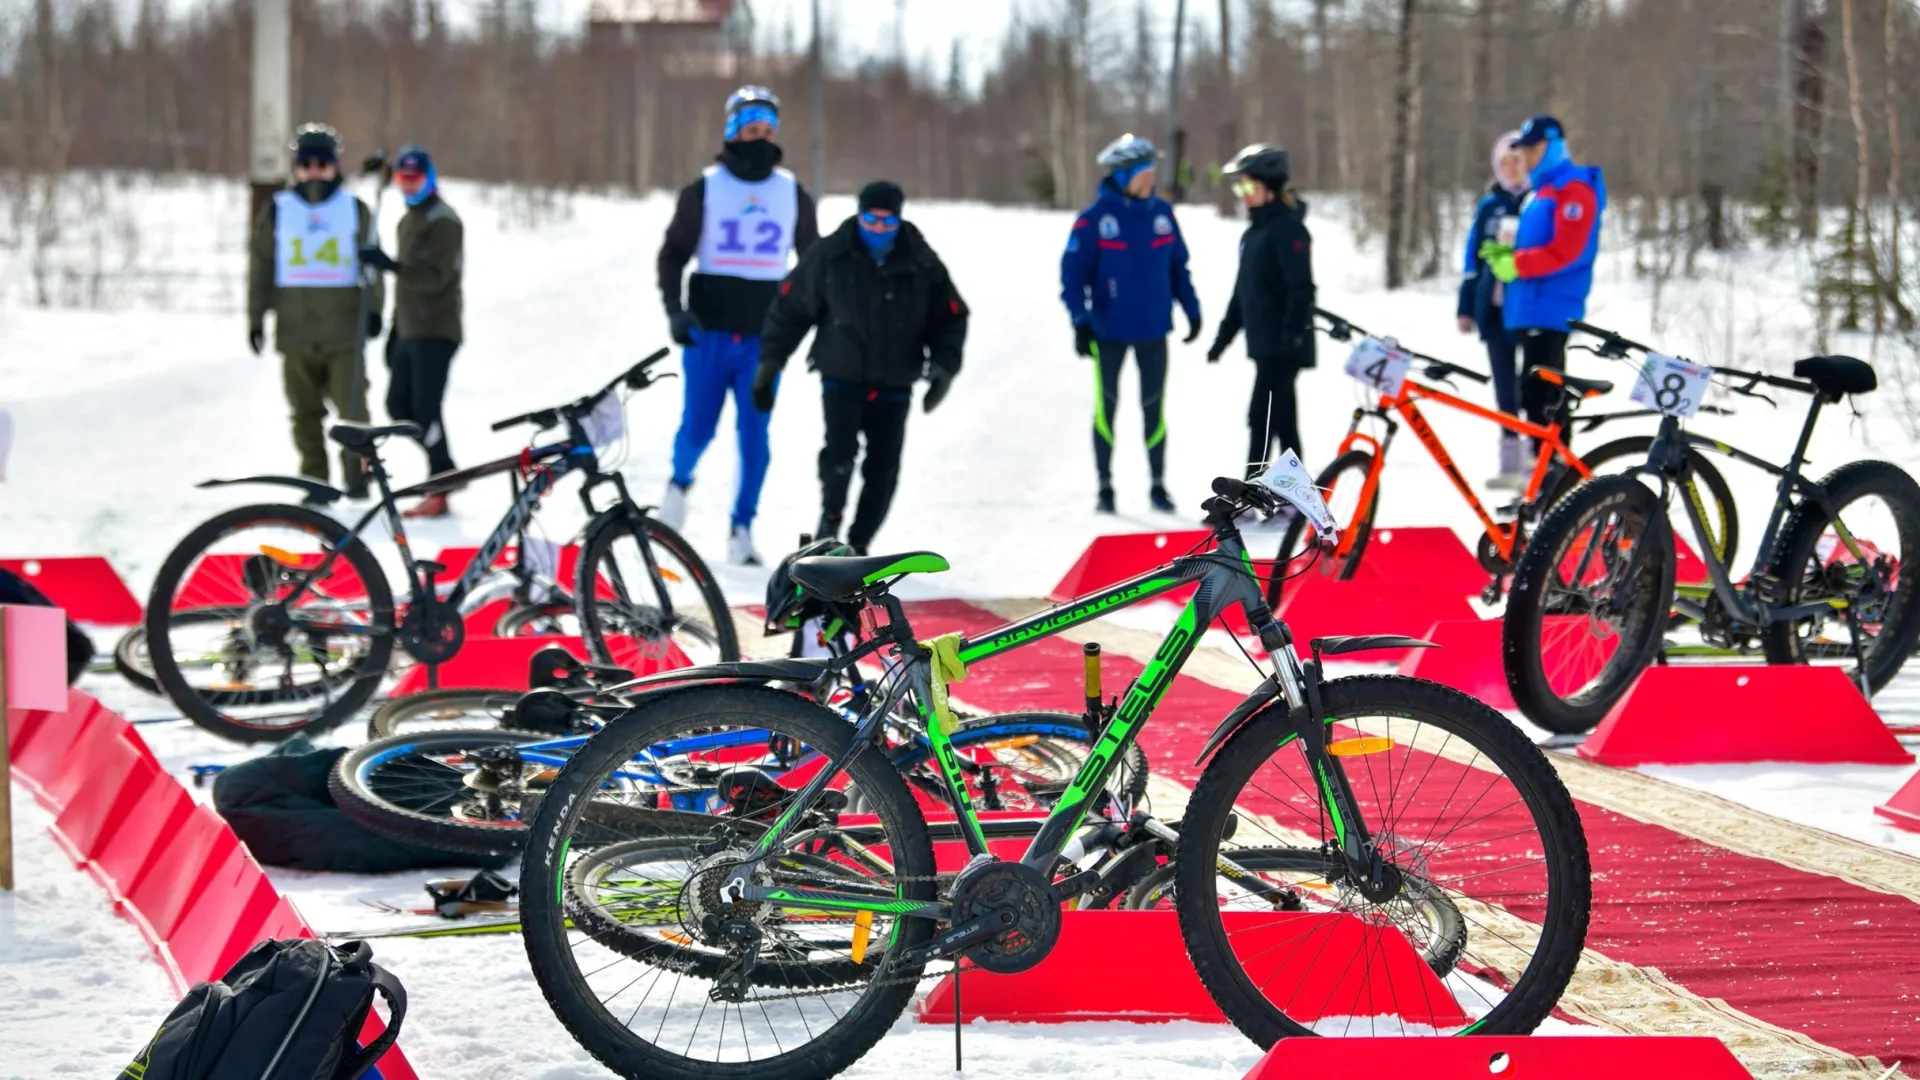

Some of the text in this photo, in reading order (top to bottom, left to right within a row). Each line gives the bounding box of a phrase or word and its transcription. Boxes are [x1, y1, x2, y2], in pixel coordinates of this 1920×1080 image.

[288, 236, 339, 268] 14
[716, 218, 783, 254] 12
[1655, 373, 1686, 410] 8
[993, 585, 1141, 648] NAVIGATOR
[1073, 624, 1189, 793] STELS
[942, 742, 972, 810] 610
[1328, 775, 1353, 834] STELS
[544, 793, 577, 868] KENDA
[945, 924, 980, 944] STELS
